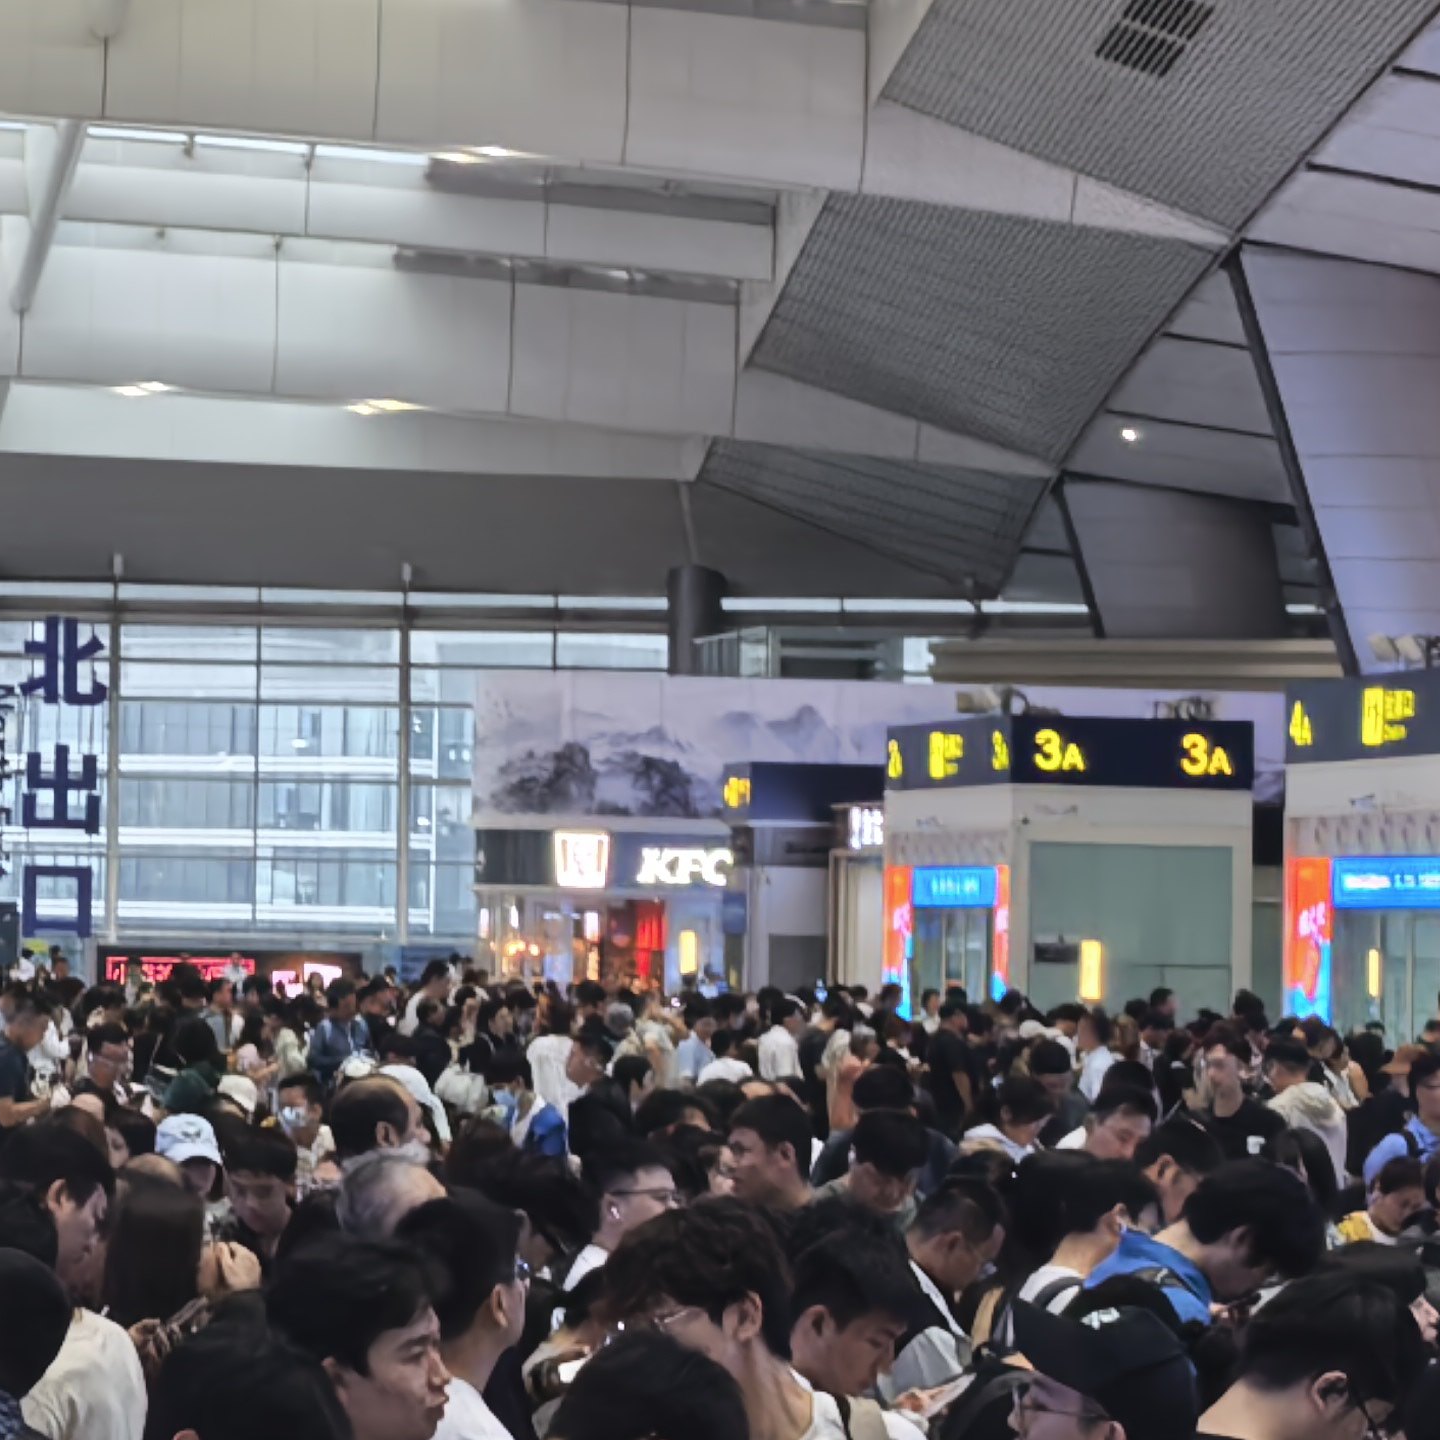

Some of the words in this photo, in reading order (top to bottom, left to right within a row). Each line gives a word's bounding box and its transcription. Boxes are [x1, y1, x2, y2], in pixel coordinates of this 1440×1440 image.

[1289, 700, 1313, 746] 4A
[1033, 728, 1086, 773] 3A
[1180, 733, 1234, 777] 3A
[17, 615, 108, 938] 北出口
[636, 847, 735, 887] KFC
